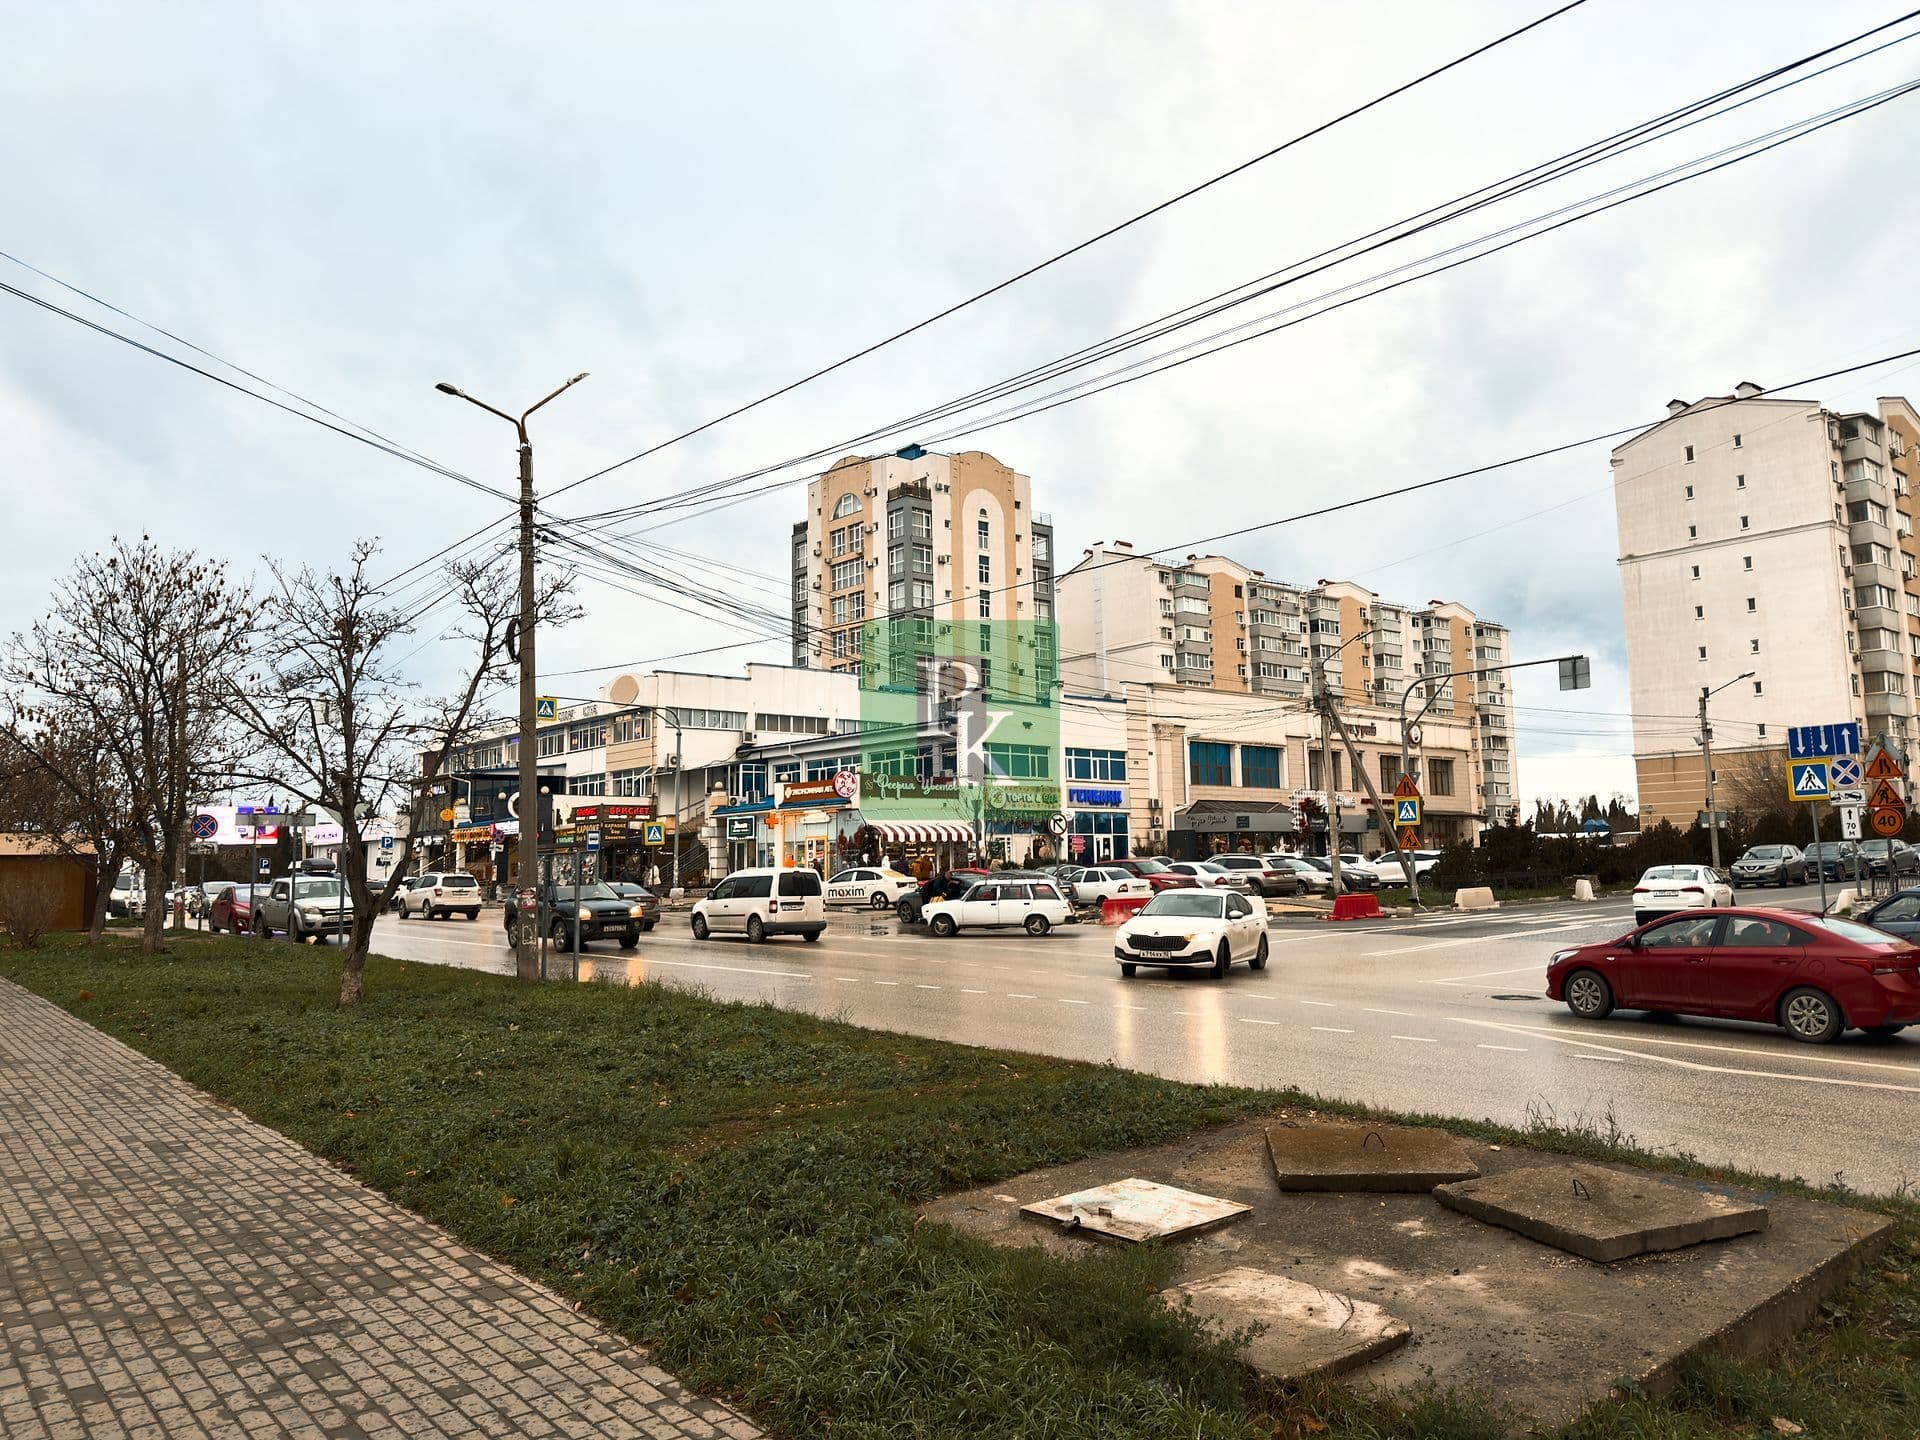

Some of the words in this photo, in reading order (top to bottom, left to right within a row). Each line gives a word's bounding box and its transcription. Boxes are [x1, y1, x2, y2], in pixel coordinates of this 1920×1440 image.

[609, 807, 650, 815] БРИСКЕТ
[1877, 815, 1897, 827] 40
[1846, 822, 1857, 830] 70
[827, 886, 865, 897] maxim
